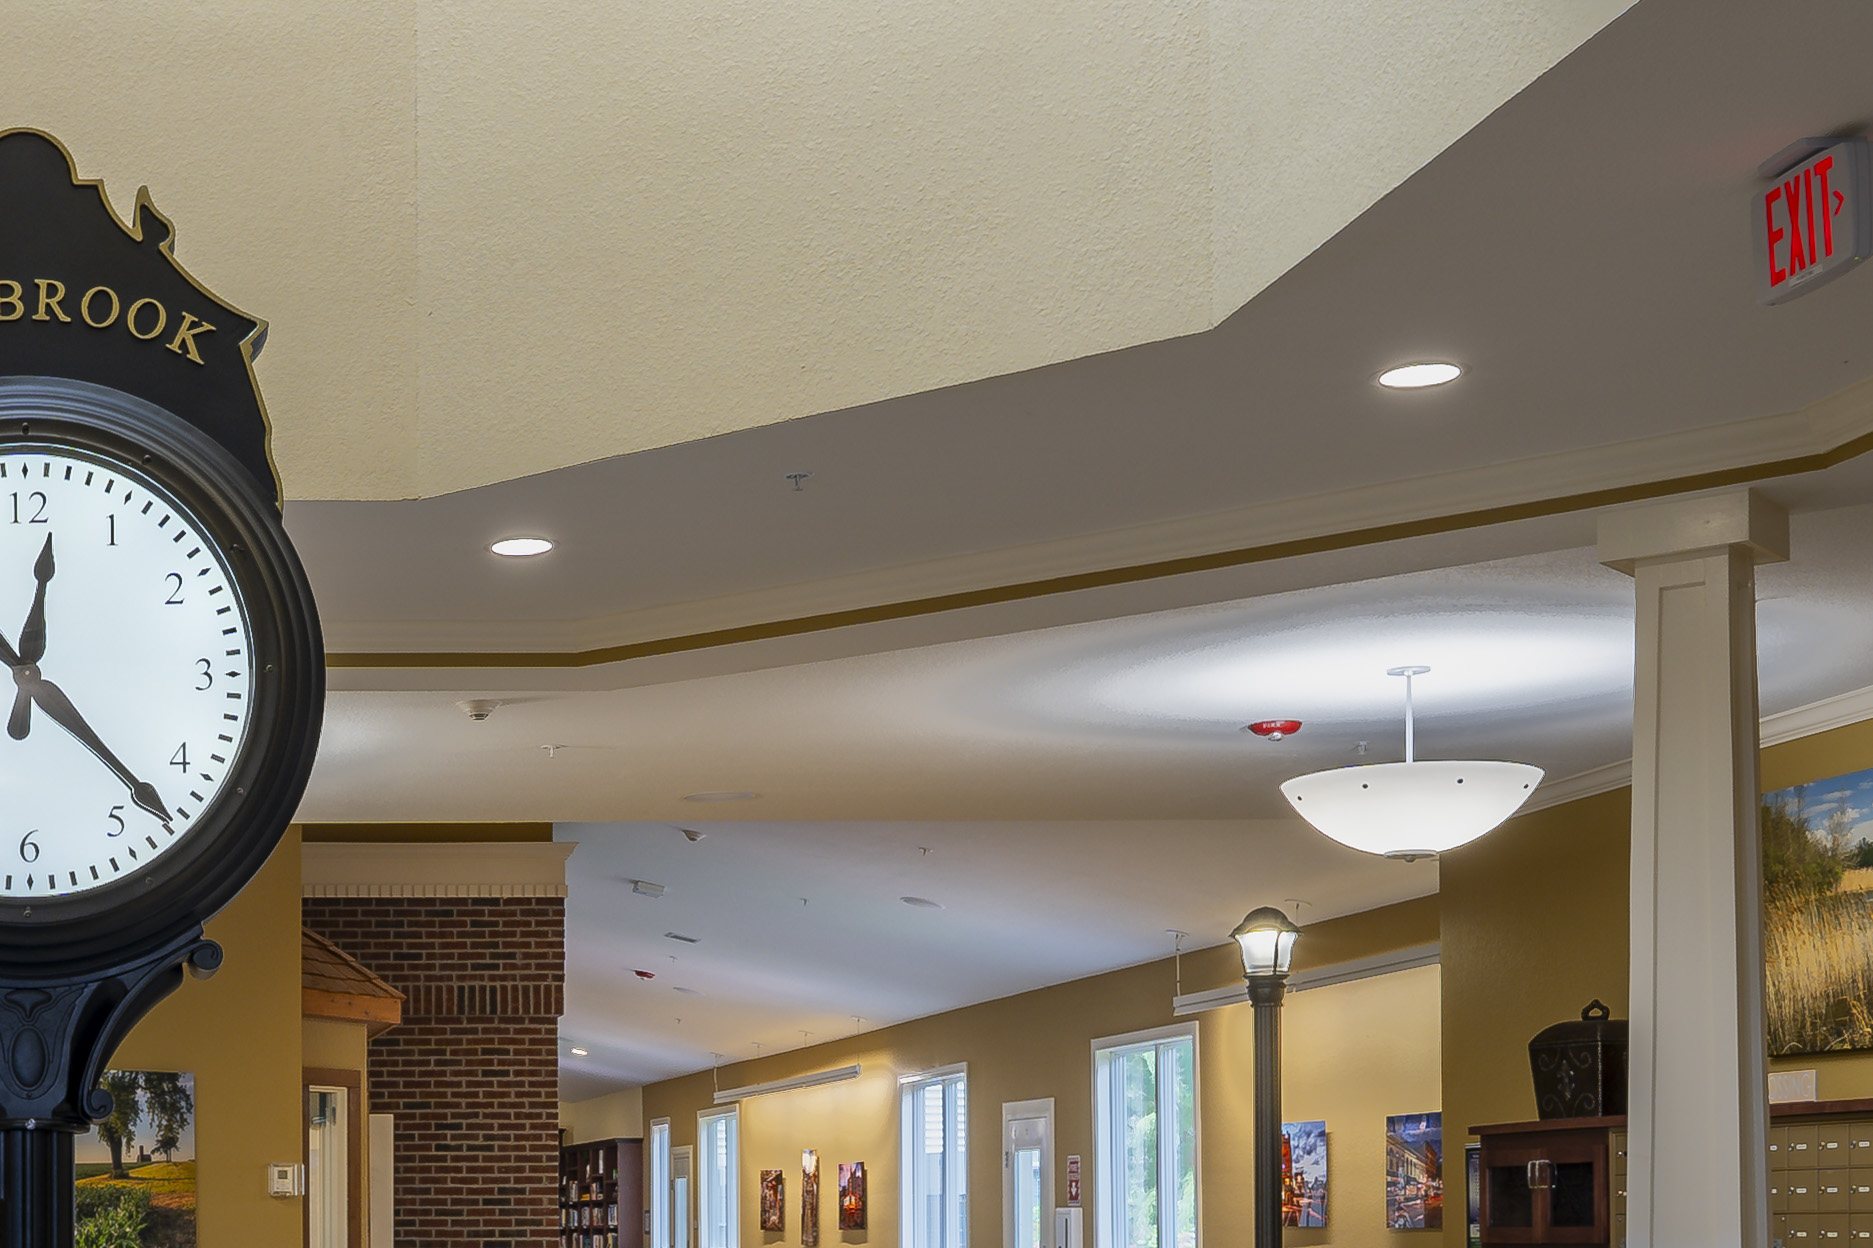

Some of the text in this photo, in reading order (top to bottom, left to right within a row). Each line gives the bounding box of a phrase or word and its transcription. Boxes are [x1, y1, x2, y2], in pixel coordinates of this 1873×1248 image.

[1765, 156, 1833, 288] EXIT
[8, 491, 49, 524] 12
[106, 513, 118, 546] 1
[164, 572, 184, 605] 2
[194, 658, 214, 691] 3
[169, 741, 191, 774] 4
[106, 805, 126, 838] 5
[19, 830, 40, 863] 6
